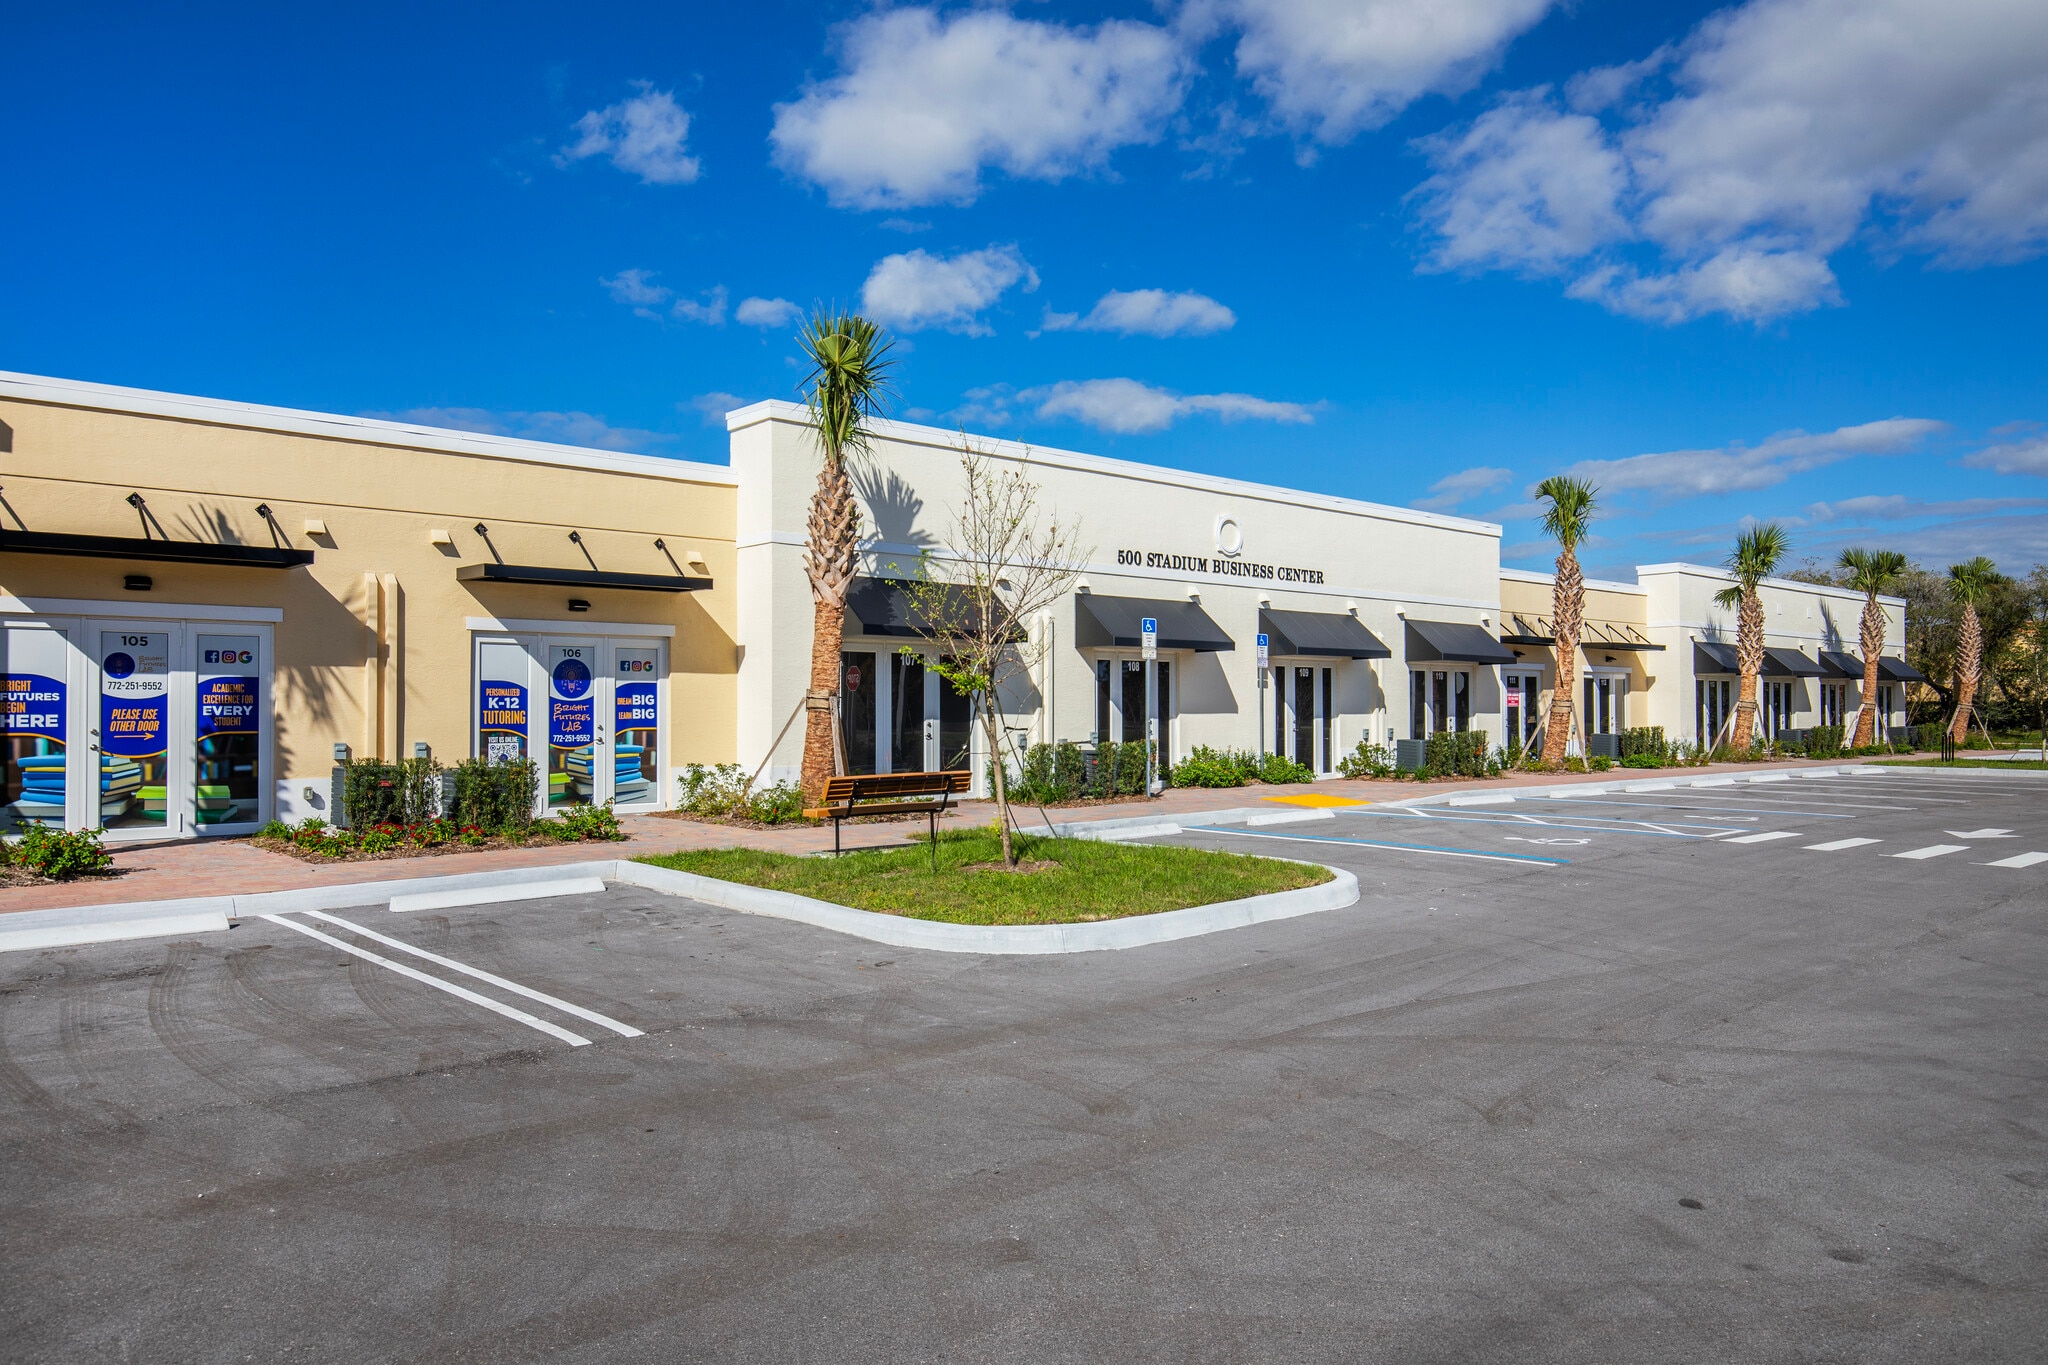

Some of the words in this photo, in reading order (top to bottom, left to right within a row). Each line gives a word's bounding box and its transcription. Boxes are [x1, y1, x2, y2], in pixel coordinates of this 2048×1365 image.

[1117, 550, 1142, 566] 500
[1147, 552, 1208, 573] STADIUM
[1212, 559, 1274, 579] BUSINESS
[1277, 567, 1324, 585] CENTER
[121, 635, 148, 647] 105
[562, 648, 582, 658] 106
[900, 654, 917, 666] 107
[1128, 661, 1140, 672] 108
[0, 680, 32, 692] BRIGHT
[107, 681, 162, 691] 772-251-9552
[212, 683, 245, 693] ACADEMIC
[485, 687, 521, 697] PERSONALIZED
[0, 692, 60, 701] FUTURES
[202, 694, 240, 704] EXCELLENCE
[241, 694, 254, 705] FOR
[632, 694, 655, 706] BIG
[0, 701, 26, 713] BEGIN
[488, 697, 520, 709] K-12
[111, 708, 141, 720] PLEASE
[142, 708, 159, 720] USE
[202, 705, 253, 716] EVERY
[632, 708, 655, 720] BIG
[0, 714, 59, 728] HERE
[213, 716, 242, 727] STUDENT
[482, 710, 526, 725] TUTORING
[109, 720, 136, 732] OTHER
[136, 720, 160, 732] DOOR
[561, 721, 582, 732] LAB
[552, 734, 591, 743] 772-251-9552
